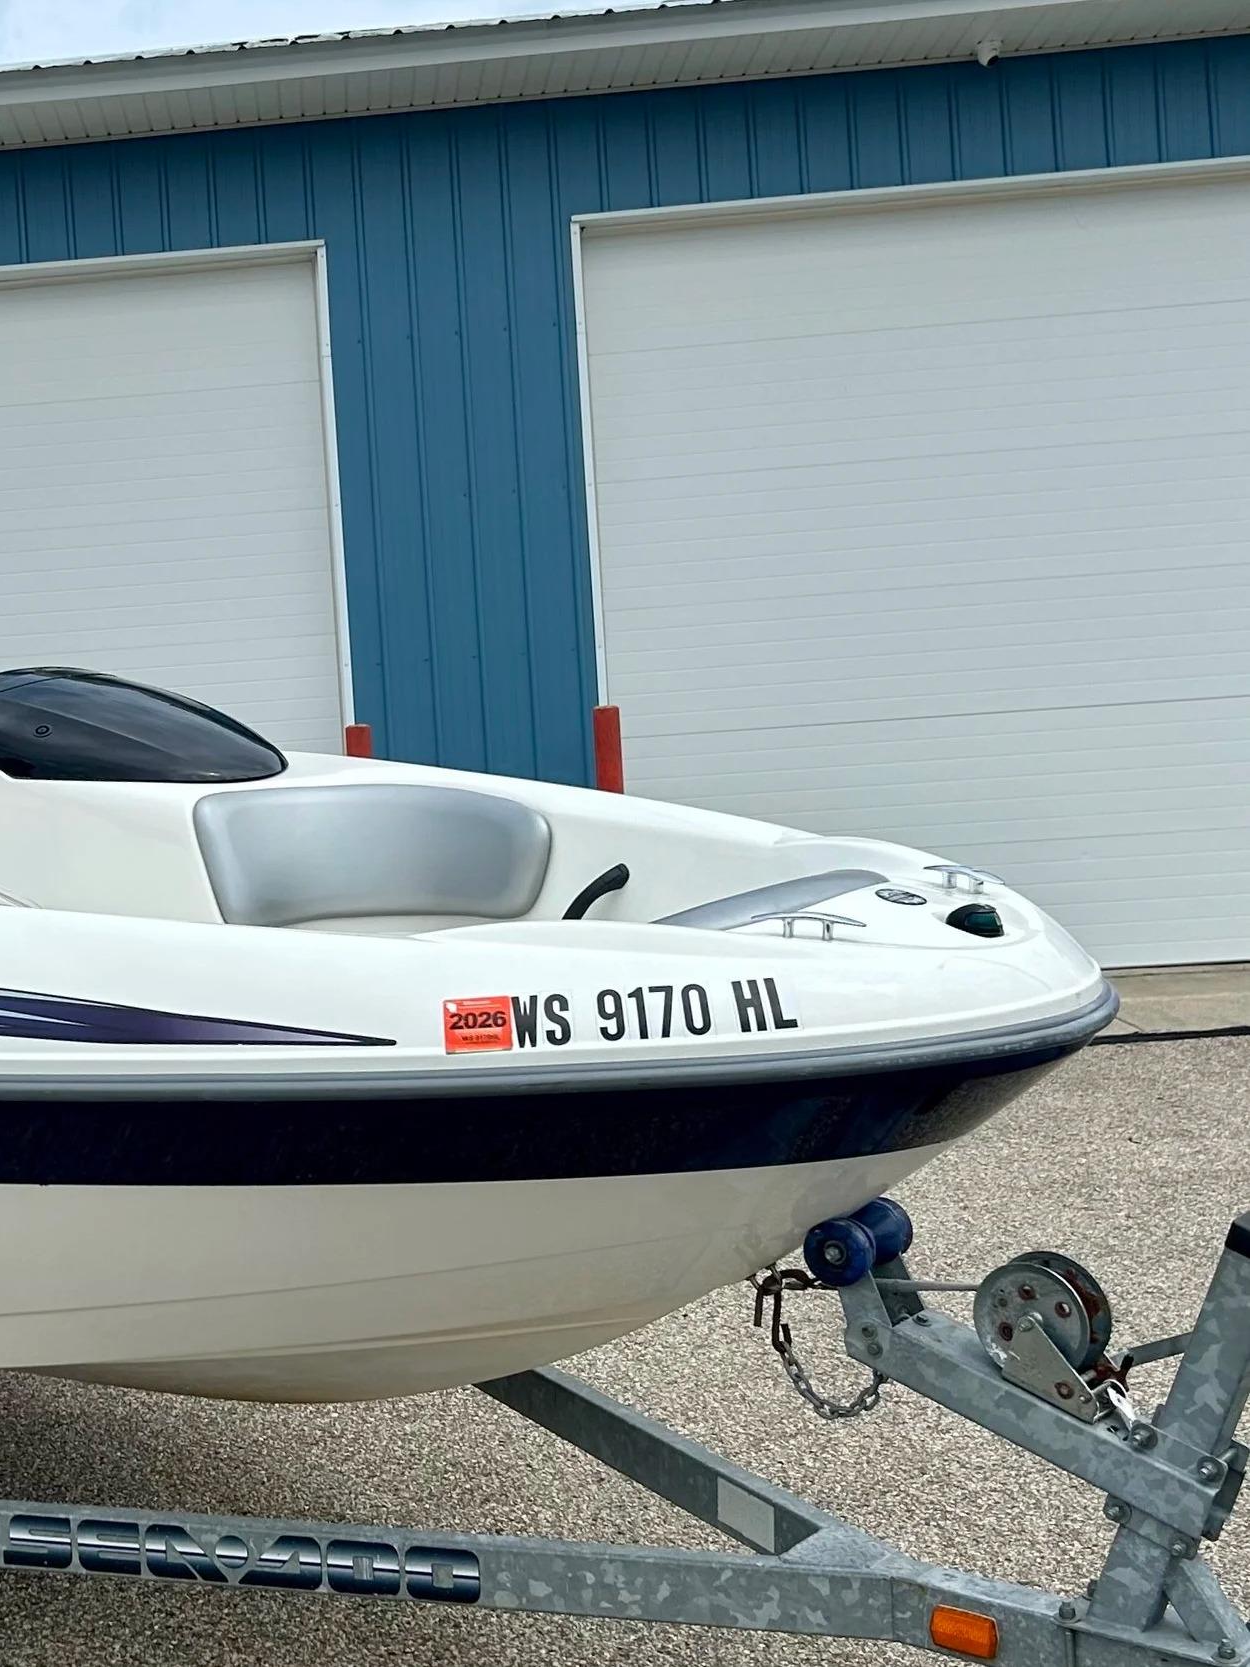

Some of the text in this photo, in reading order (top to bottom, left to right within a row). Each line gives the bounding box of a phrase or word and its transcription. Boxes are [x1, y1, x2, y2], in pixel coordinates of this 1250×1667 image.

[449, 1010, 507, 1030] 2026
[510, 977, 799, 1049] WS 9170 HL
